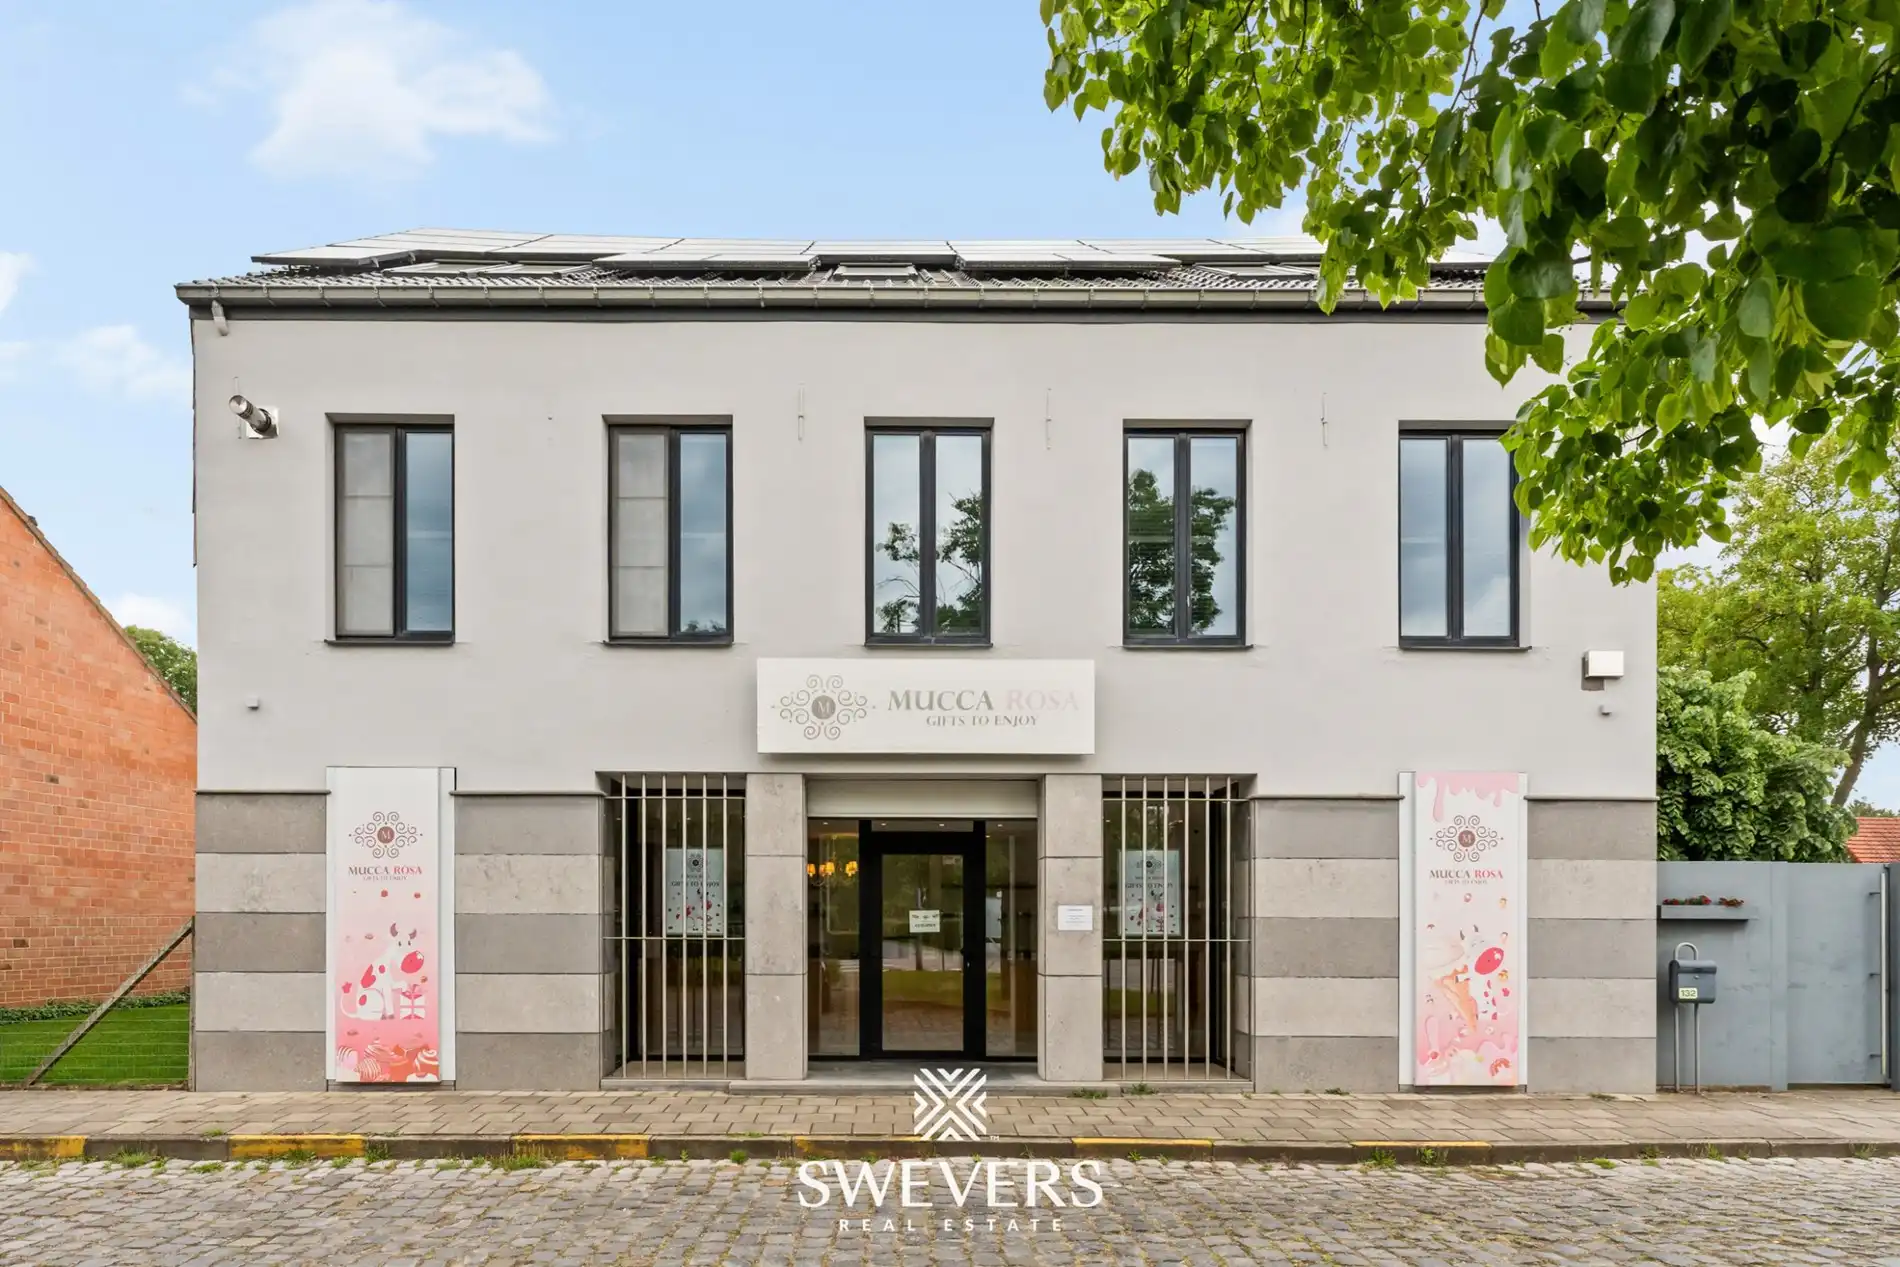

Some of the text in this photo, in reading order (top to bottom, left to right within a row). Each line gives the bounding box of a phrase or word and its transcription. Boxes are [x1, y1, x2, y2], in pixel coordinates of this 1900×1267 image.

[888, 689, 1079, 711] MUCCA ROSA
[926, 714, 1039, 728] GIFTS TO ENJOY
[348, 866, 422, 876] MUCCA ROSA
[1429, 870, 1504, 879] MUCCA ROSA
[1681, 989, 1696, 997] 132
